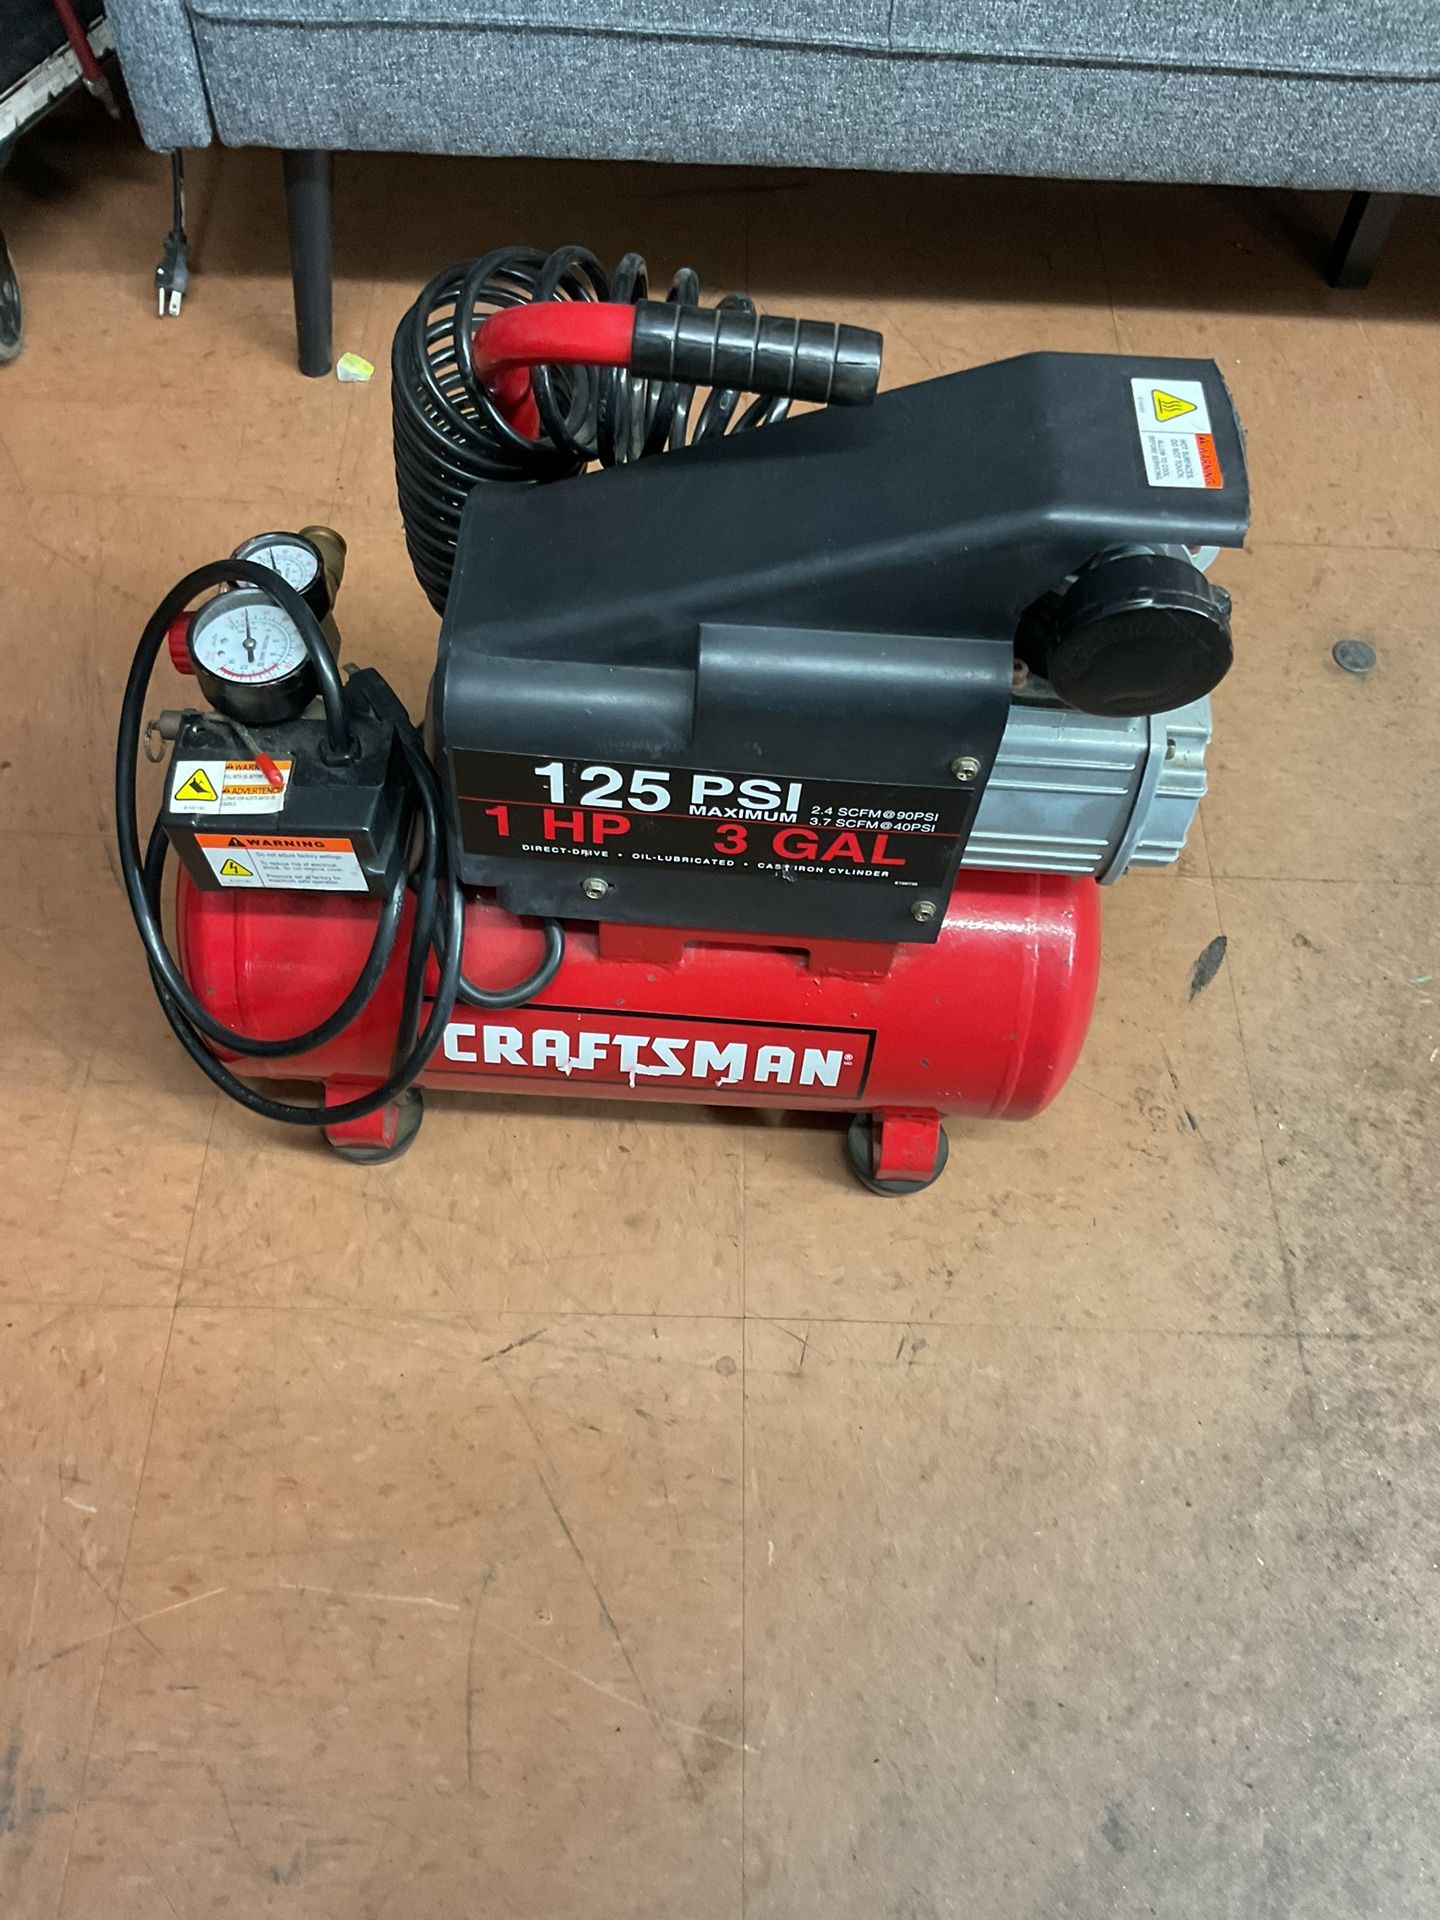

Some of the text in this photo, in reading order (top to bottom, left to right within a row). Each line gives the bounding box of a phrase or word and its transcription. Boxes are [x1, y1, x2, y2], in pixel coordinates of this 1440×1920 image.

[1200, 448, 1216, 485] WARNING
[534, 762, 803, 812] 125 PSI
[689, 804, 798, 824] MAXIMUM
[809, 817, 936, 832] 3.7 SCFM@40PSI
[811, 806, 939, 822] 2.4 SCFM@90PSI
[246, 839, 326, 848] WARNING
[485, 805, 906, 866] 1 HP 3 GAL
[522, 844, 889, 878] DIRECT-DRIVE OIL-LUBRICATED CAST IRON CYLINDER
